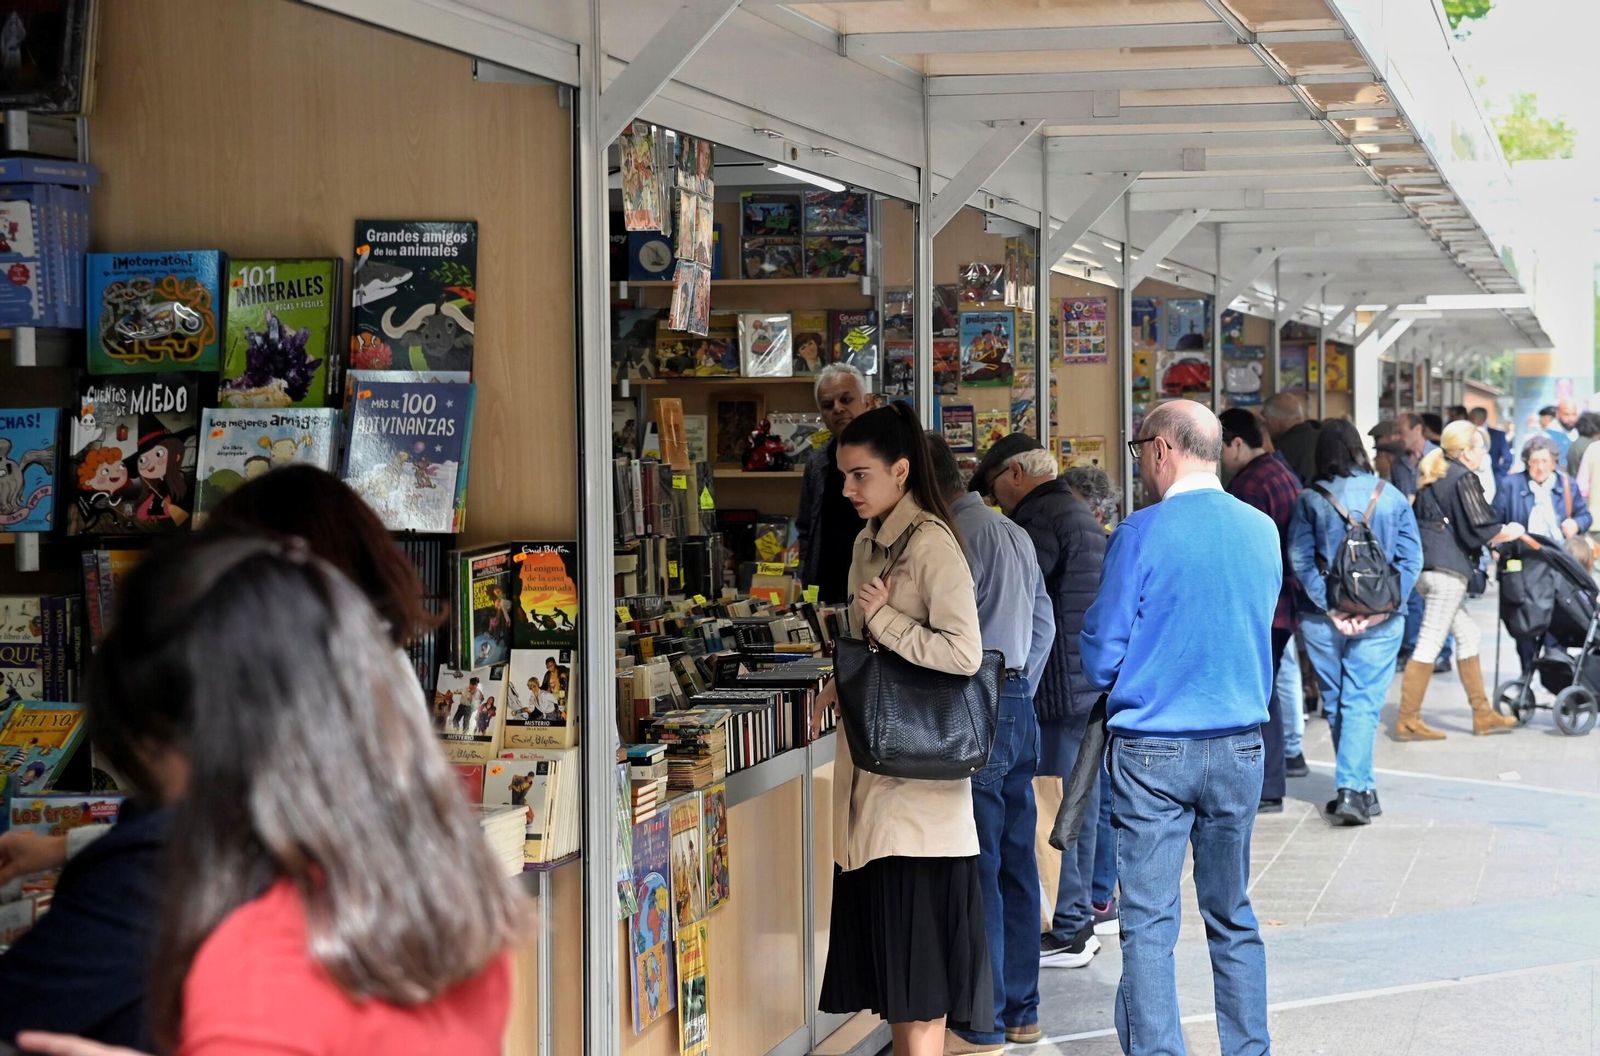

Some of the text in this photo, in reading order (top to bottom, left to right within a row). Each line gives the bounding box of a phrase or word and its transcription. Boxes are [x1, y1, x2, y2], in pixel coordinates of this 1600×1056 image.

[366, 229, 468, 246] Grandes amigos
[373, 244, 459, 257] de los animales
[112, 254, 193, 269] ¡Motorratón!
[239, 266, 277, 287] 101
[236, 275, 324, 308] MINERALES
[965, 314, 1009, 325] pulgarcito
[87, 383, 188, 415] CUENTOS MIEDO
[371, 393, 436, 415] MÁS DE 100
[116, 406, 127, 416] DE
[210, 418, 227, 428] Los
[228, 419, 268, 430] mejores
[355, 416, 455, 437] ADIVINANZAS
[521, 545, 571, 555] Enid Blyton
[534, 567, 564, 575] enigma
[523, 584, 573, 592] abandonada
[50, 713, 78, 727] YO!
[535, 735, 561, 747] Blyton
[457, 748, 486, 761] Blyton
[12, 804, 81, 825] Los tres
